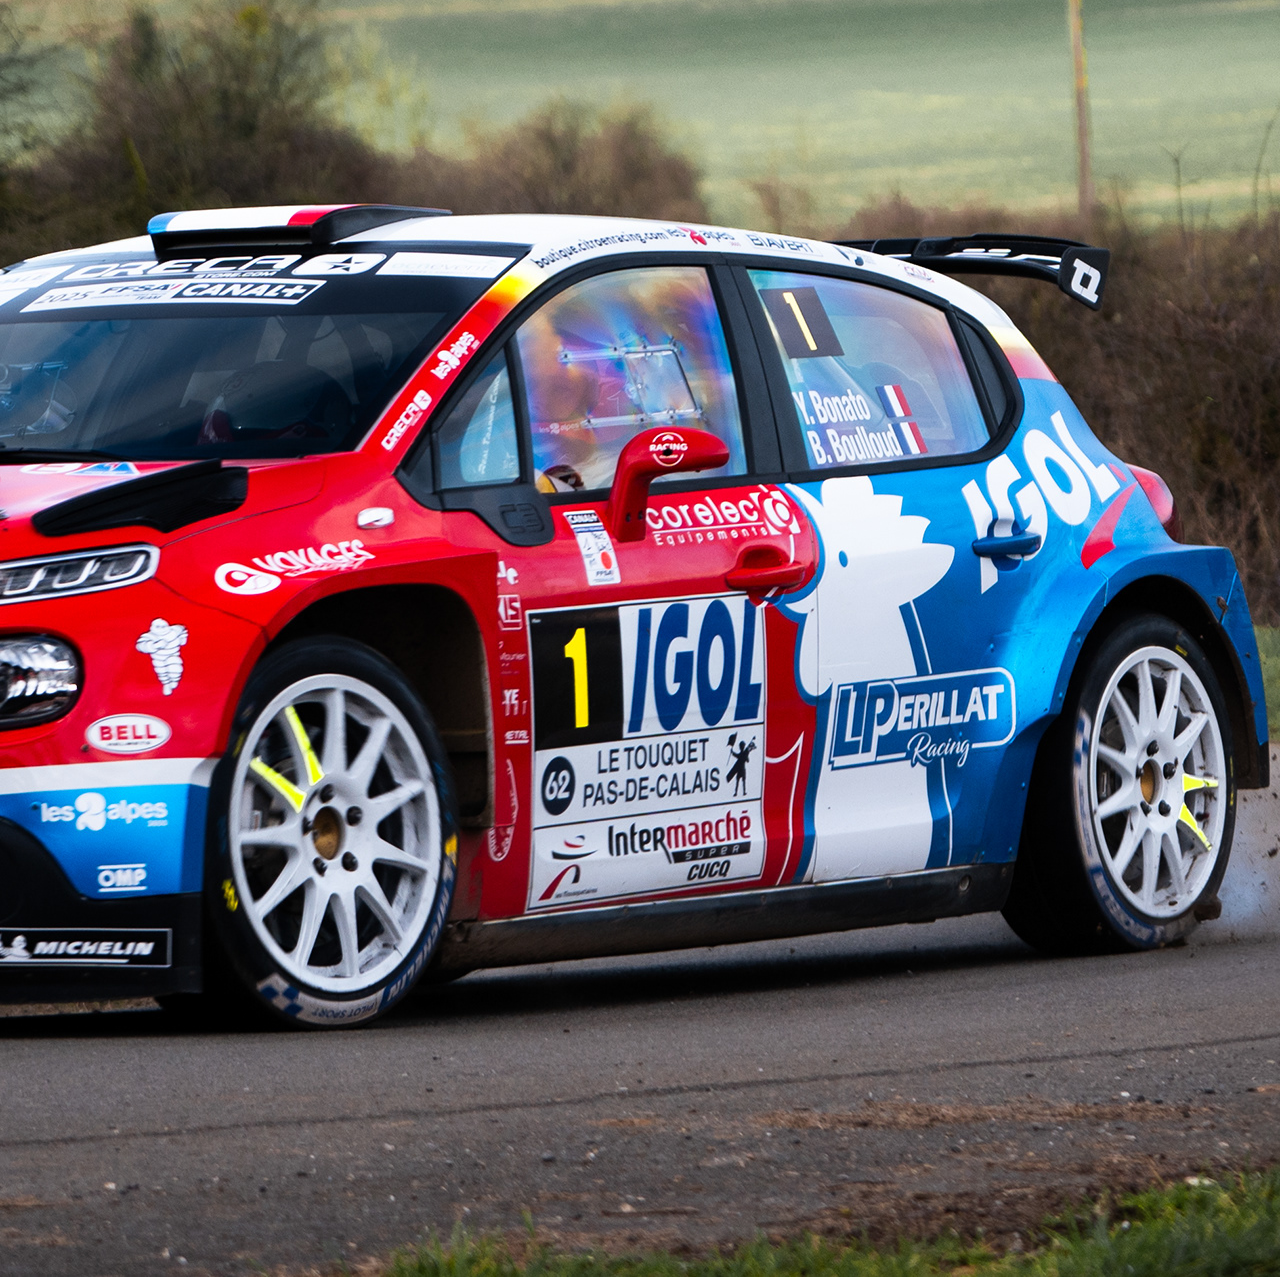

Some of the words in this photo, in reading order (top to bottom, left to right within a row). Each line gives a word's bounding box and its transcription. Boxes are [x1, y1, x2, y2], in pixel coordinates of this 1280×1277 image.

[530, 230, 669, 269] boutique.citroenracing.com
[746, 233, 815, 254] BIAVERT
[63, 254, 303, 279] ORECA
[193, 270, 277, 280] STORE.COM
[34, 290, 89, 305] 2025
[182, 282, 308, 298] CANAL+
[782, 291, 818, 351] 1
[430, 361, 452, 380] les
[450, 331, 475, 358] alpes
[791, 391, 816, 425] Y.
[808, 388, 871, 425] Bonato
[381, 403, 420, 451] ORECA
[807, 429, 833, 465] B.
[826, 423, 904, 464] Boulloud
[499, 503, 545, 533] C3
[646, 496, 759, 530] corelec
[961, 410, 1121, 595] IGOL
[653, 525, 768, 546] Equipements
[251, 538, 377, 573] VOYAGES
[563, 627, 590, 729] 1
[627, 598, 763, 734] IGOL
[99, 724, 159, 741] BELL
[906, 731, 970, 768] Racing
[597, 748, 620, 775] LE
[623, 738, 710, 771] TOUQUET
[544, 769, 571, 802] 62
[582, 767, 721, 808] PAS-DE-CALAIS
[40, 802, 76, 823] les
[74, 792, 107, 831] 2
[106, 799, 169, 824] alpes
[98, 868, 147, 887] OMP
[686, 859, 731, 882] CUCQ
[33, 940, 155, 956] MICHELIN
[347, 1002, 375, 1018] PILOT
